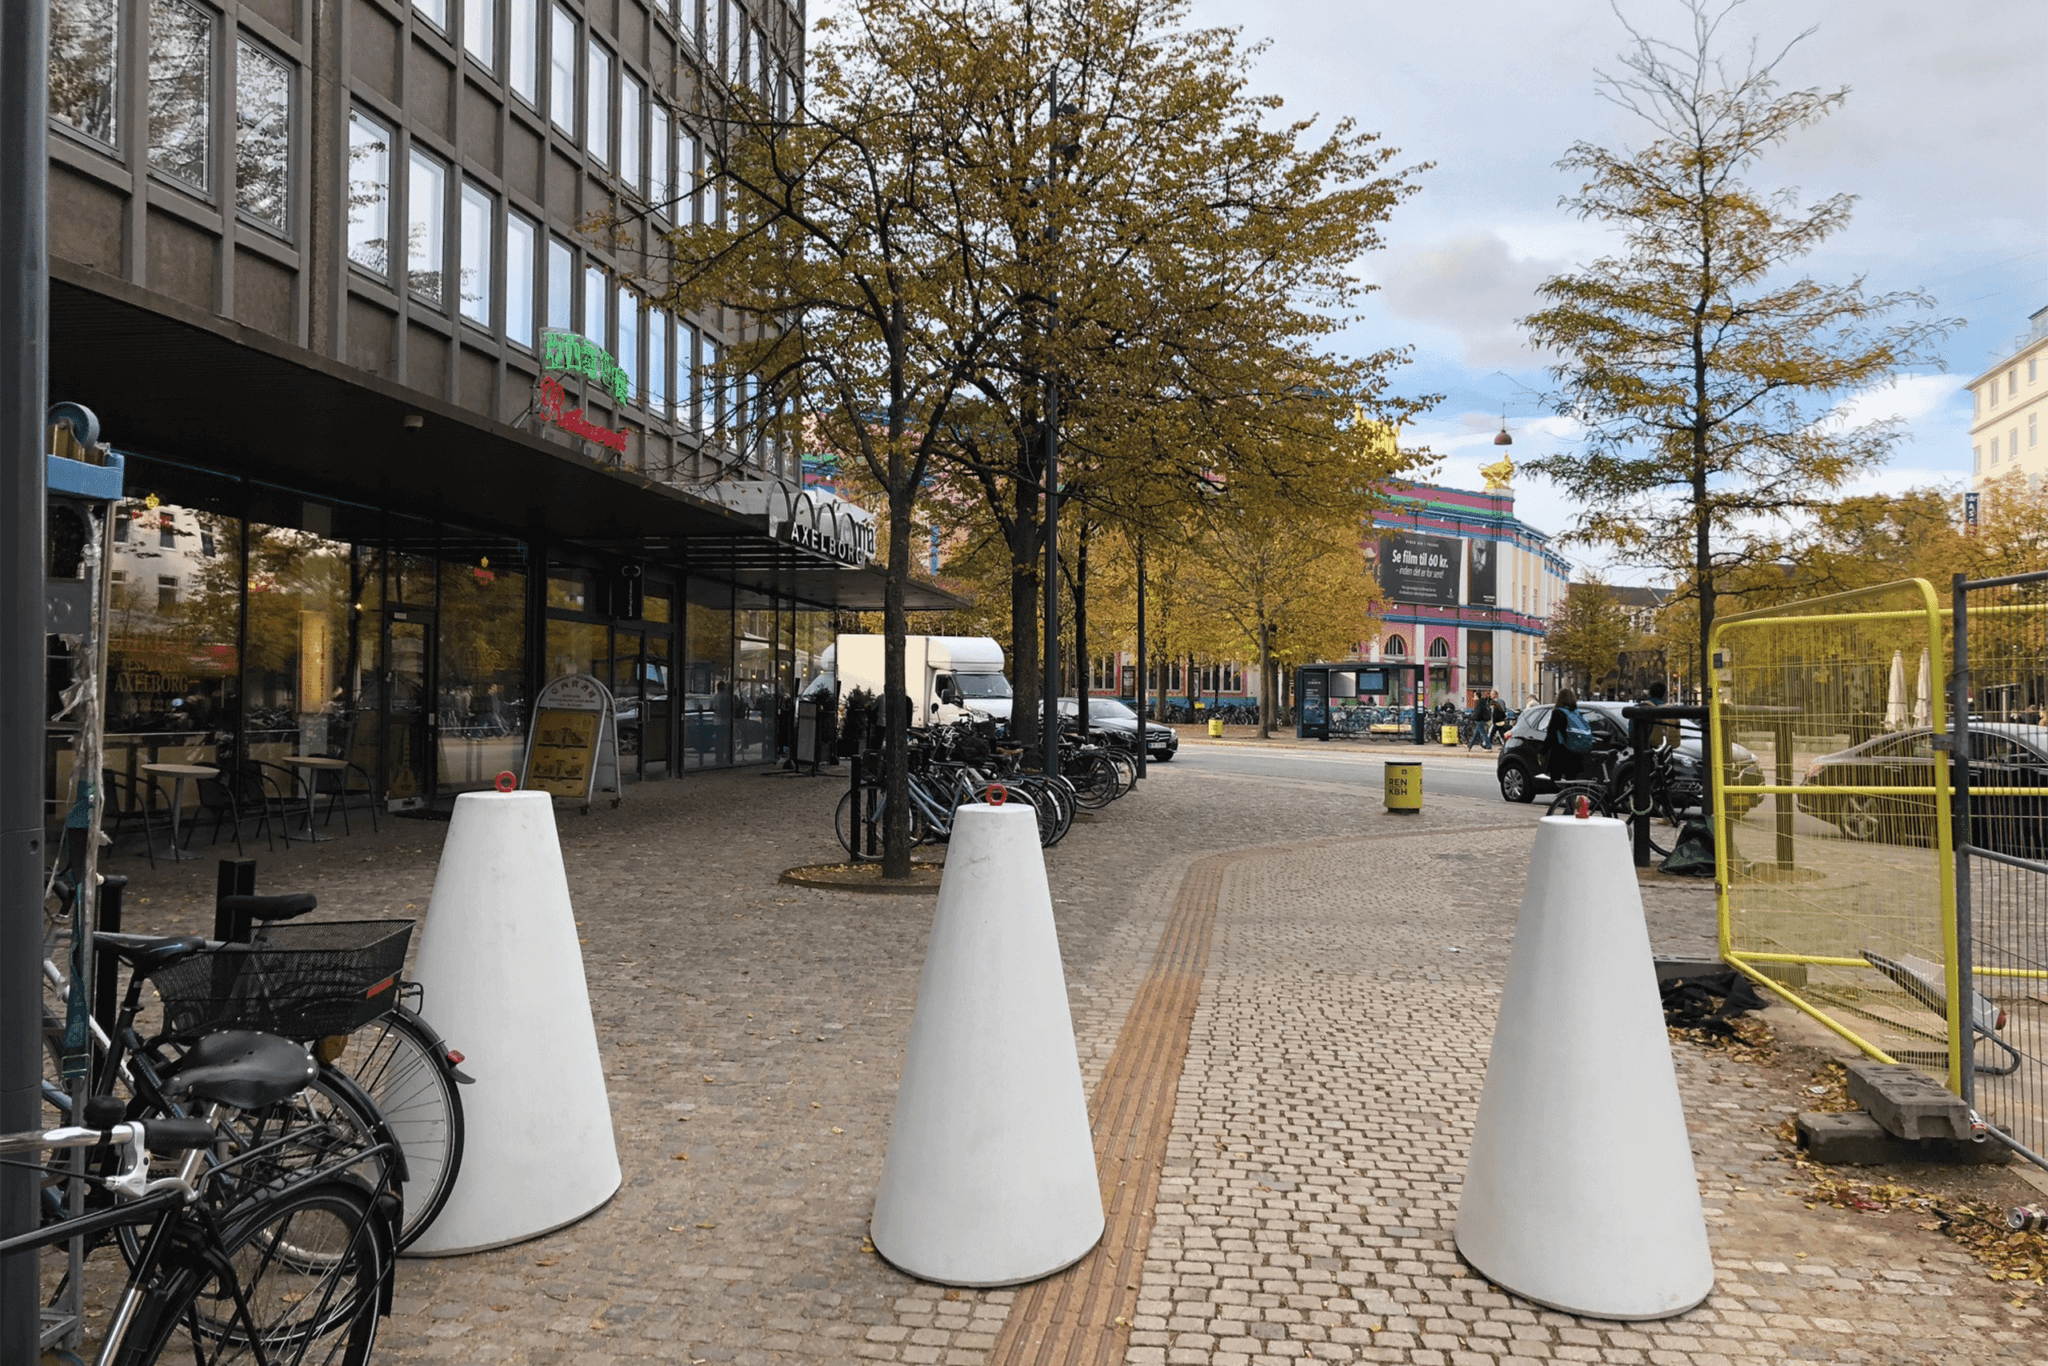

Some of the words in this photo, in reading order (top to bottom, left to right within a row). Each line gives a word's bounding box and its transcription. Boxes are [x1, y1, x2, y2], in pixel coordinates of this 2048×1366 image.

[791, 521, 865, 565] AXELBORG
[1392, 549, 1402, 563] Se
[1402, 549, 1418, 565] film
[1419, 552, 1428, 566] til
[1428, 554, 1439, 568] 60
[1439, 554, 1449, 569] kr.
[1399, 565, 1413, 576] inden
[1413, 566, 1421, 577] det
[114, 671, 189, 692] AXELBORG
[1389, 778, 1407, 786] REN
[1389, 788, 1407, 796] KBH
